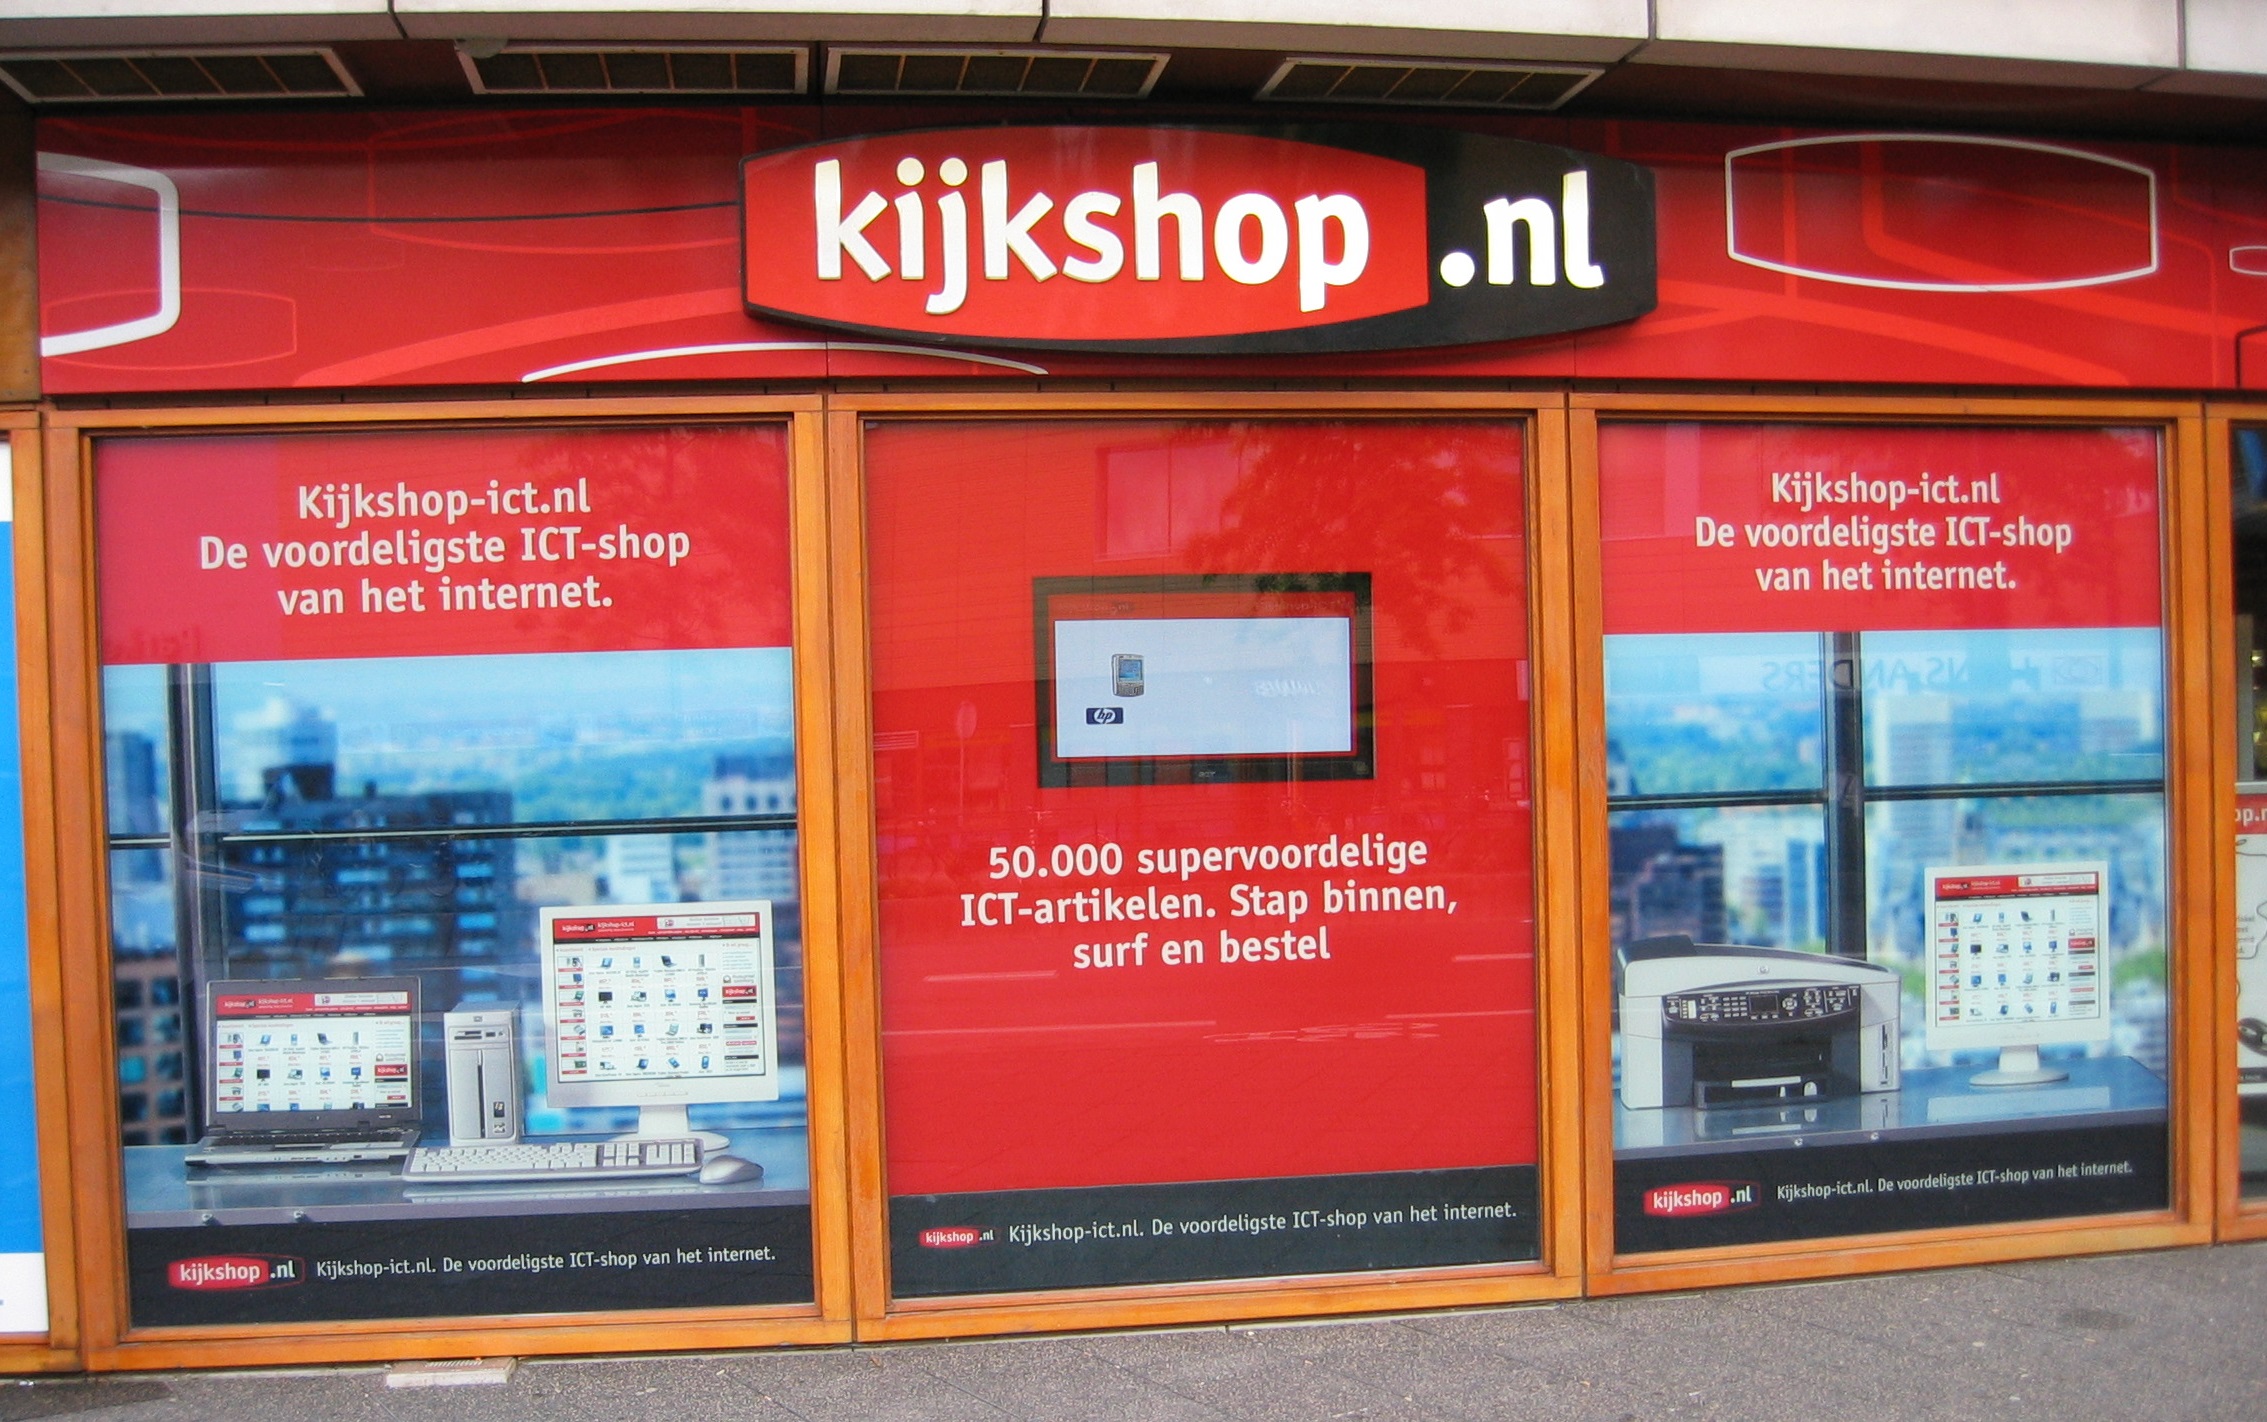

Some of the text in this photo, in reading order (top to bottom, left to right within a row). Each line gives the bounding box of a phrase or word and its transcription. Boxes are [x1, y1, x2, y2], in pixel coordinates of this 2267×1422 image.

[300, 478, 590, 528] Kijkshop-ict.nl
[1772, 471, 2000, 512] Kijkshop-ict.nl
[201, 524, 689, 573] De voordeligste ICT-shop
[1696, 515, 2072, 554] De voordeligste ICT-shop
[277, 576, 614, 616] van het internet.
[1755, 559, 2016, 592] van het internet.
[990, 833, 1427, 881] 50.000 supervoordelige
[961, 880, 1456, 926] ICT-artikelen. Stap binnen,
[1074, 926, 1330, 968] surf en bestel
[1777, 1160, 2133, 1203] Kijkshop-ict.nl. De voordeligste ICT-shop van het internet.
[1009, 1202, 1517, 1247] Kijkshop-ict.nl. De voordeligste ICT-shop van het internet.
[316, 1246, 776, 1280] Kijkshop-ict.nl. De voordeligste ICT-shop van het internet.
